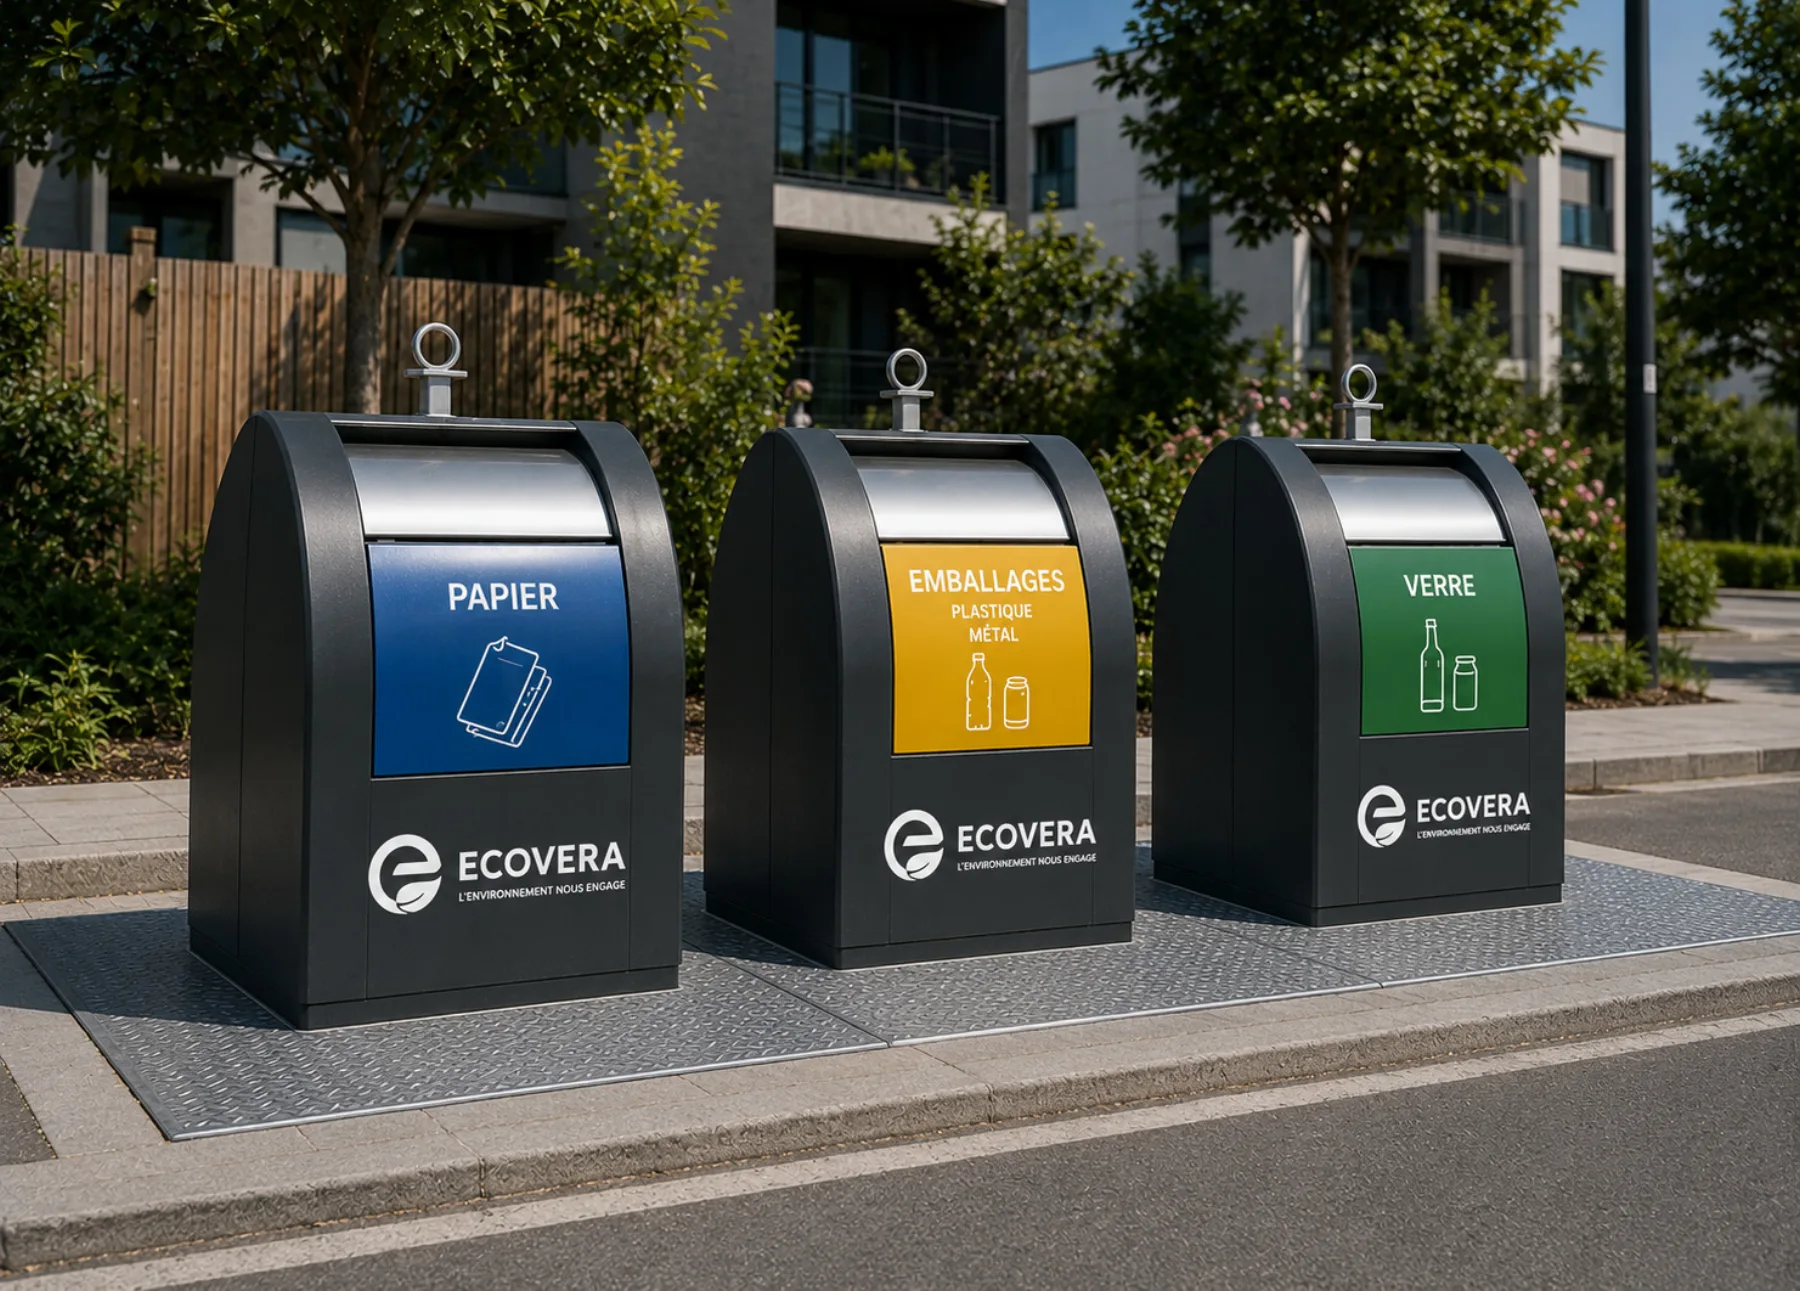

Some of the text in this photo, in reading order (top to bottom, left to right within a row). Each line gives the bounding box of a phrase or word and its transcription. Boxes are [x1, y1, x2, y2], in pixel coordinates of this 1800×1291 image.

[908, 569, 1065, 593] EMBALLAGES
[1403, 574, 1476, 597] VERRE
[448, 582, 559, 611] PAPIER
[951, 603, 1033, 621] PLASTIQUE
[969, 624, 1019, 643] MÉTAL
[1417, 792, 1531, 823] ECOVERA
[958, 818, 1097, 852] ECOVERA
[1482, 824, 1503, 834] NOUS
[459, 841, 626, 881] ECOVERA
[957, 853, 1097, 871] L'ENVIRONNEMENT NOUS ENGAGE
[458, 880, 626, 902] L'ENVIRONNEMENT NOUS ENGAGE
